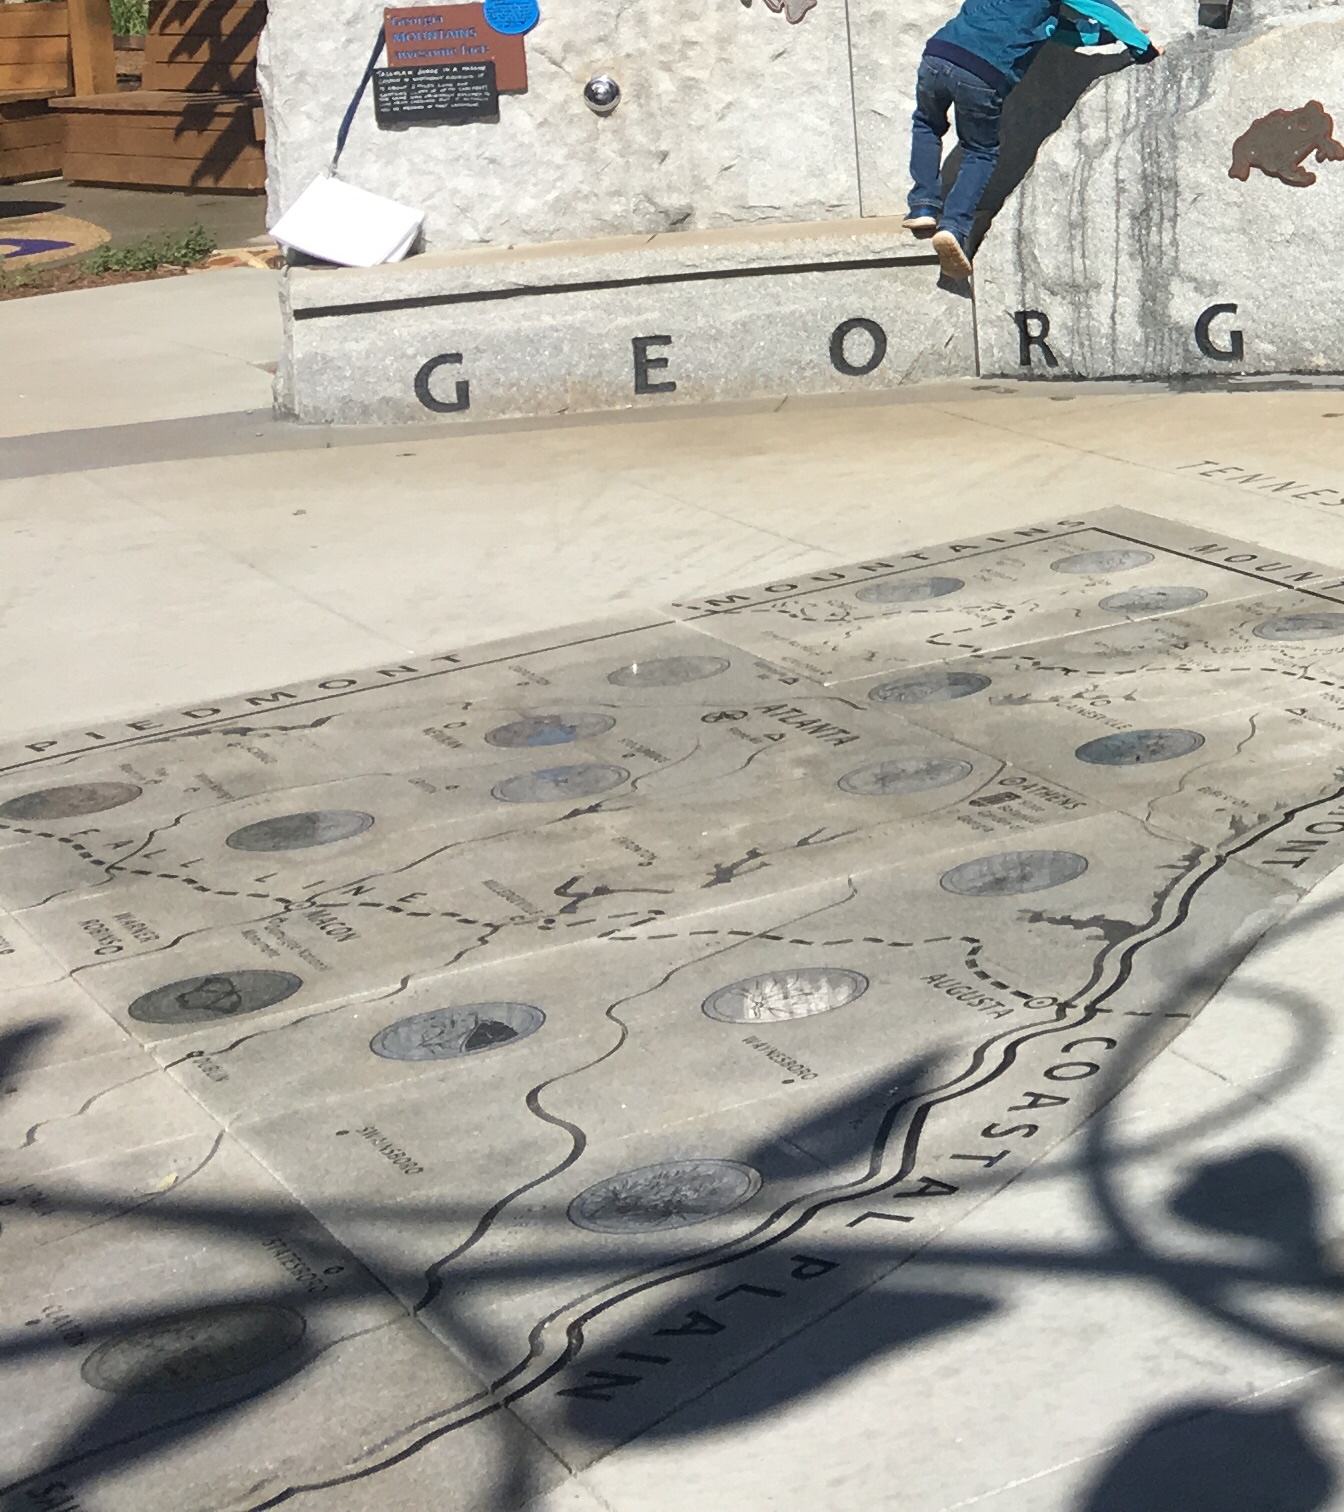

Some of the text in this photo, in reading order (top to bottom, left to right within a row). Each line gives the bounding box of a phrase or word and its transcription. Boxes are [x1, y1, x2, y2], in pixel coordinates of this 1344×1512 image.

[705, 518, 1087, 611] MOUNTAINS
[25, 653, 463, 753] PIEDMONT
[754, 702, 861, 748] ATLANTA
[1021, 782, 1088, 810] ATHENS
[920, 972, 1019, 1021] AUGUSTA
[740, 1034, 820, 1081] WAYNESBORO
[556, 1035, 1118, 1403] COASTAL PLAIN
